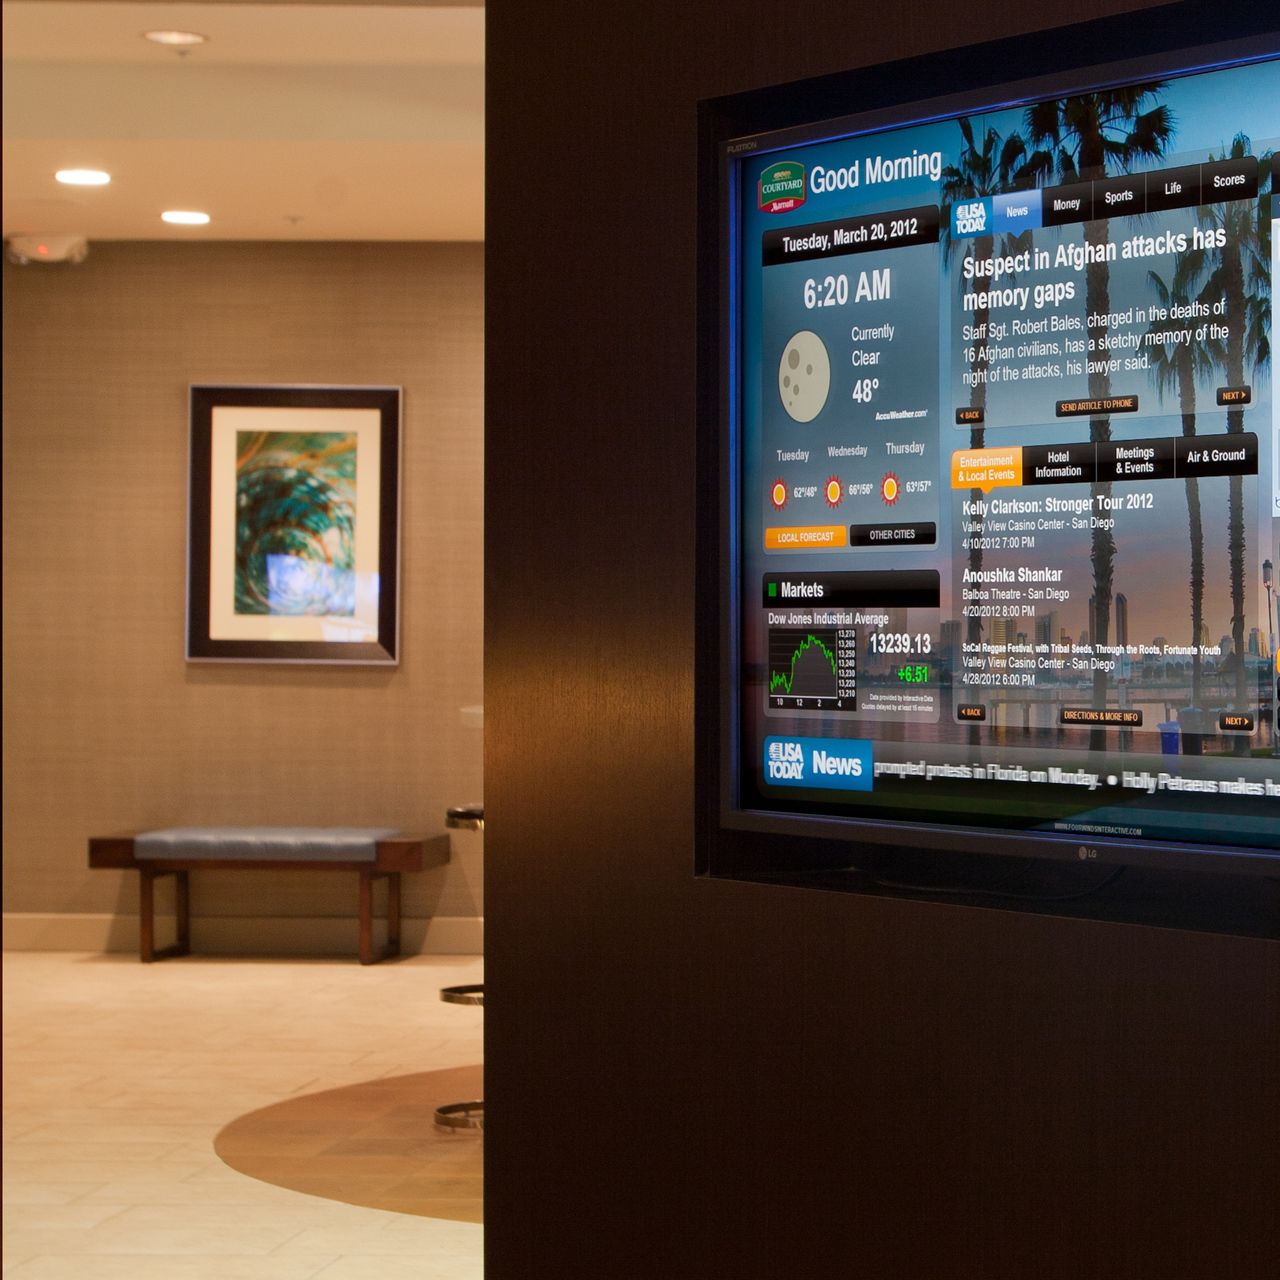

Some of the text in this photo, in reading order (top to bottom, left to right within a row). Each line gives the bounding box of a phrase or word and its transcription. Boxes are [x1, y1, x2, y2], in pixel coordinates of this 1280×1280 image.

[810, 150, 942, 194] Good Morning
[762, 179, 803, 194] COURTYARD
[1006, 173, 1246, 219] News Money Sports Life Scores
[966, 202, 986, 219] USA
[783, 218, 918, 253] Tuesday, March 20, 2012
[963, 227, 1227, 280] Suspect in Afghan attacks has
[804, 268, 891, 310] 6:20 AM
[963, 280, 1075, 312] memory gaps
[963, 298, 1226, 341] Staff Sgt. Robert Bales, charged in the deaths of
[851, 322, 895, 342] Currently
[963, 322, 1229, 365] 16 Afghan civilians, has a sketchy memory of the
[852, 350, 880, 366] Clear
[963, 353, 1152, 388] night of the attacks, his lawyer said.
[852, 378, 880, 403] 48°
[1222, 391, 1240, 401] NEXT
[1061, 398, 1133, 413] SEND ARTICLE TO PHONE
[964, 410, 979, 420] BACK
[777, 448, 810, 463] Tuesday
[828, 444, 868, 459] Wednesday
[886, 440, 925, 457] Thursday
[1047, 451, 1070, 463] Hotel
[1116, 446, 1155, 461] Meetings
[1187, 447, 1246, 463] Air & Ground
[960, 454, 1014, 468] Entertainment
[1116, 461, 1155, 474] & Events
[958, 468, 1015, 481] & Local Events
[1035, 465, 1082, 478] Information
[962, 493, 1154, 518] Kelly Clarkson: Stronger Tour 2012
[869, 528, 916, 540] OTHER CITIES
[962, 516, 1115, 535] Valley View Casino Center San Diego
[777, 531, 834, 543] LOCAL FORECAST
[962, 536, 1035, 550] 4/10/2012 7:00 PM
[962, 566, 1063, 584] Anoushka Shankar
[781, 581, 824, 598] Markets
[768, 612, 889, 628] Dow Jones Industrial Average
[870, 633, 932, 654] 13239.13
[898, 666, 929, 684] +6.51
[781, 743, 803, 762] USA
[812, 750, 863, 777] News
[1087, 849, 1097, 859] LG
